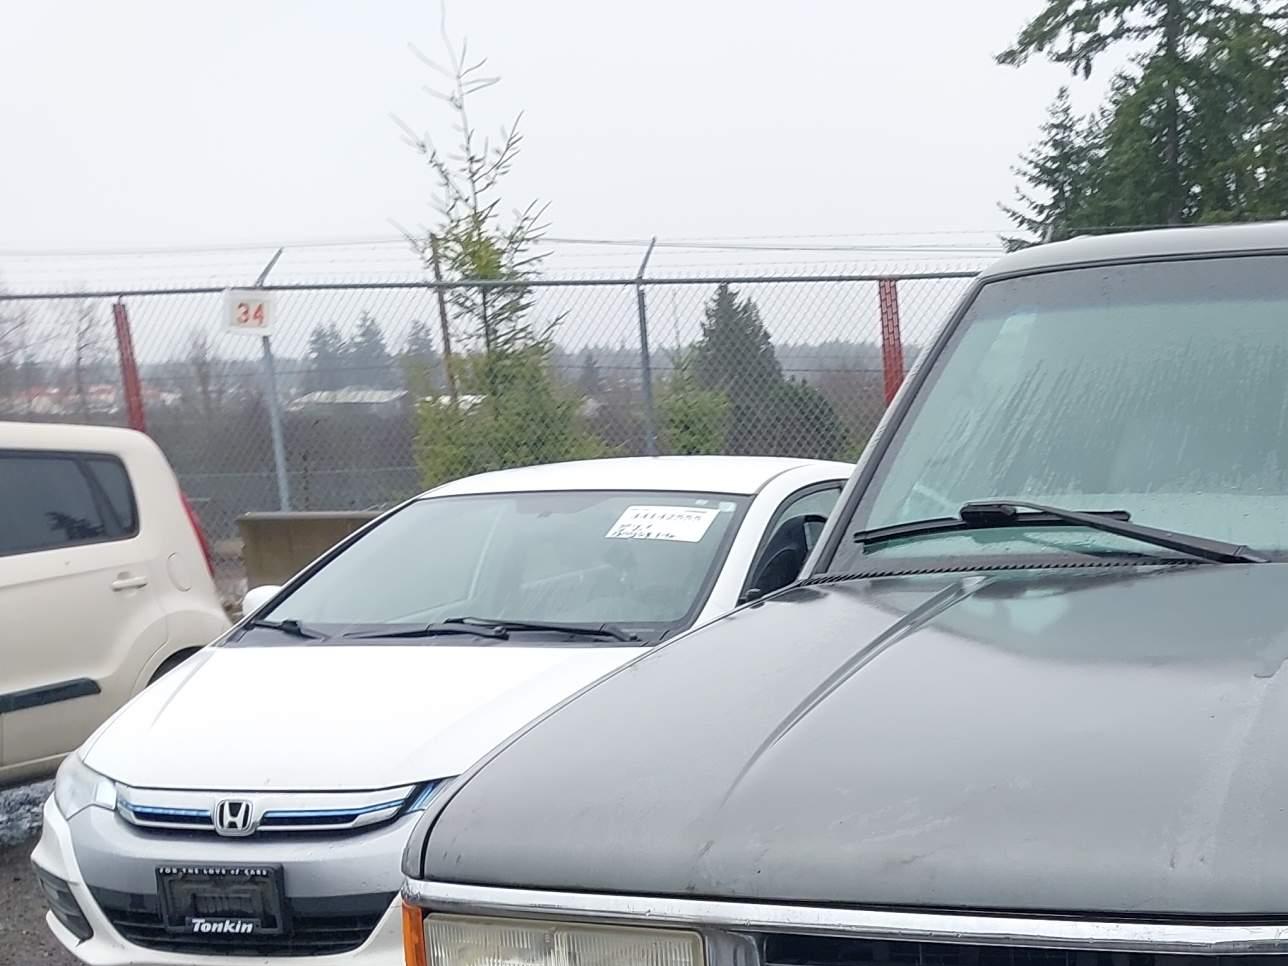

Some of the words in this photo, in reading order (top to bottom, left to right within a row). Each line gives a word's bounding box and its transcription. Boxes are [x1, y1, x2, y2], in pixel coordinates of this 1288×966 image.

[237, 303, 264, 325] 34
[203, 867, 226, 875] LOVE
[191, 918, 254, 934] Tonkin
